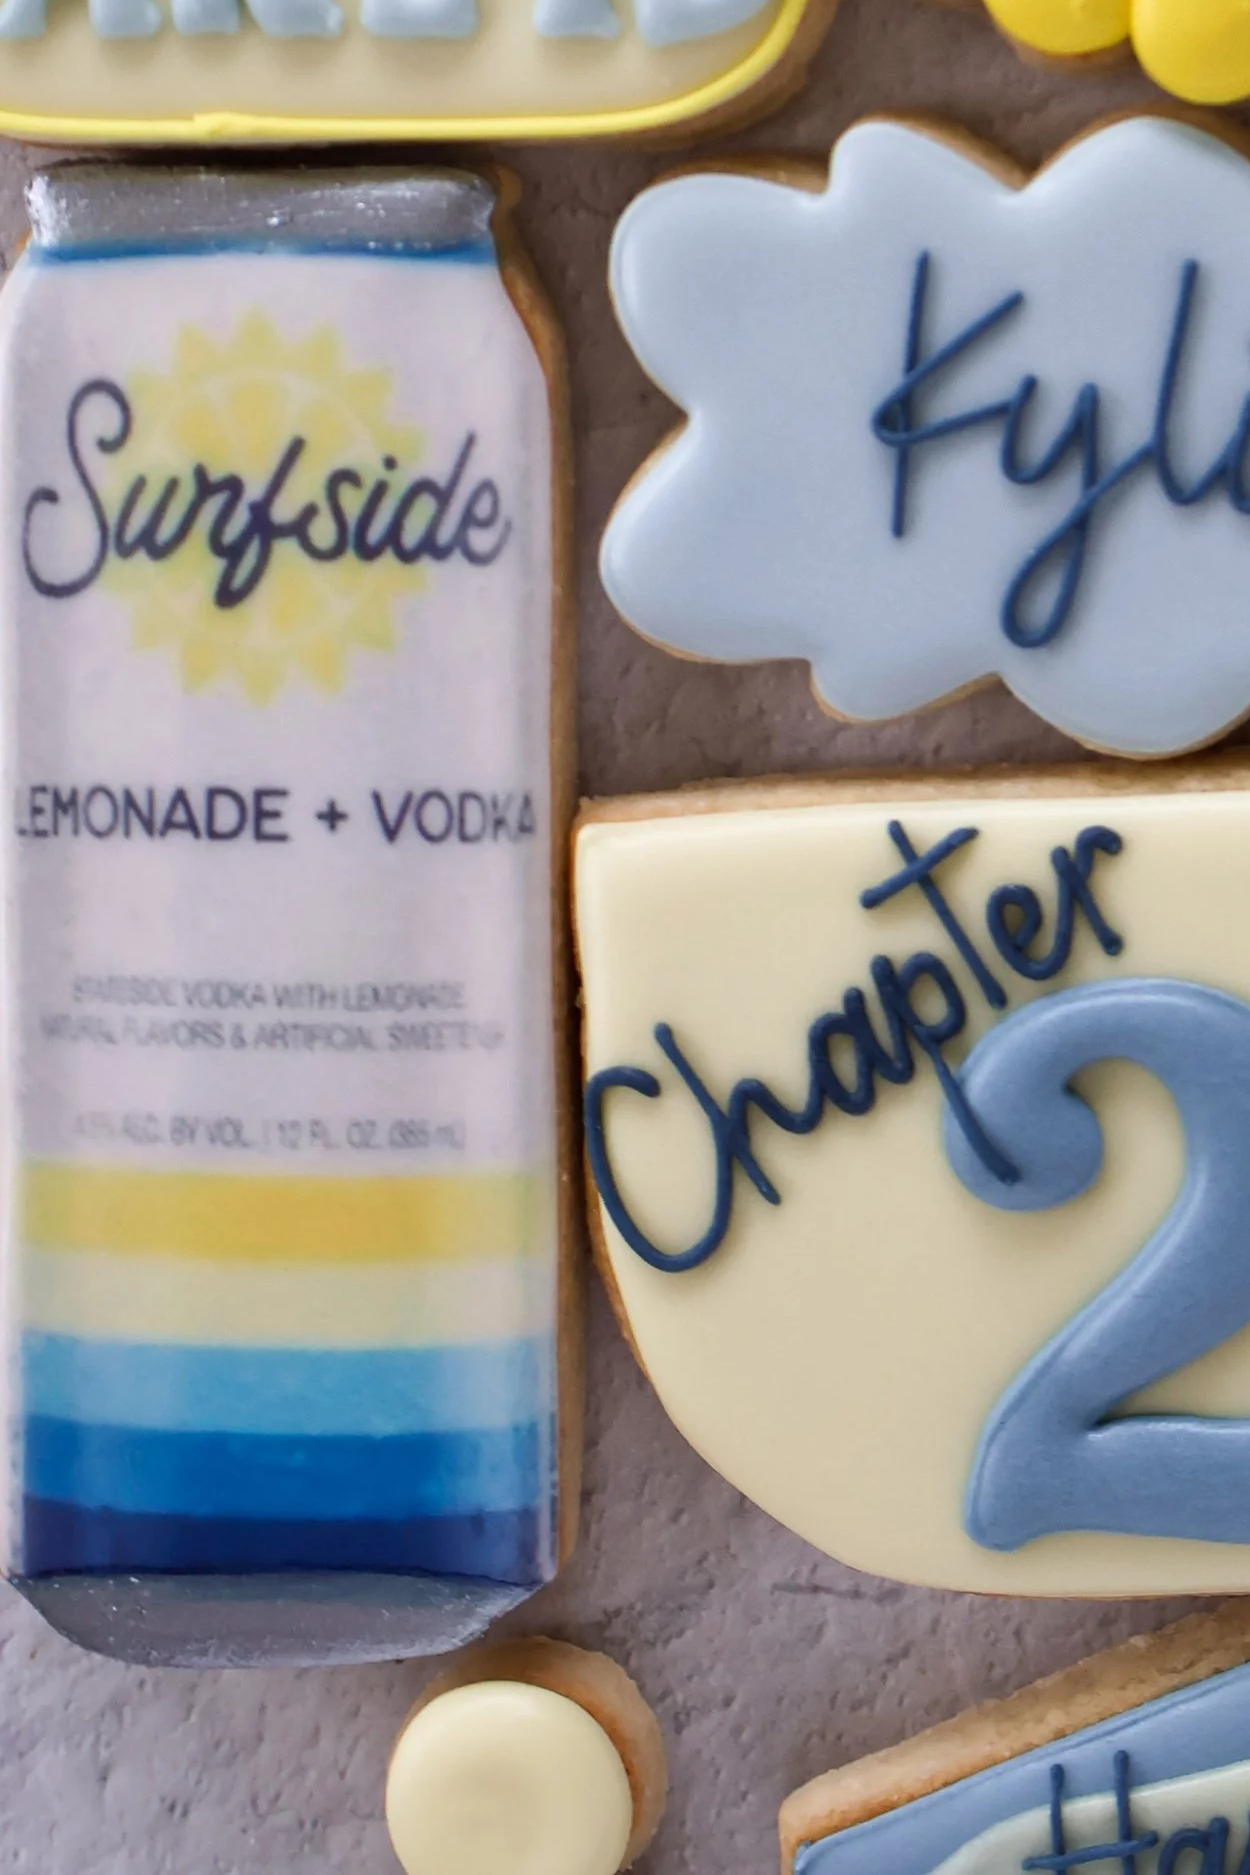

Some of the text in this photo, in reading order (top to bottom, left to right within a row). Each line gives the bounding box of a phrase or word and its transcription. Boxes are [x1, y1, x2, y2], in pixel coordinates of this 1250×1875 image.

[22, 378, 511, 609] Surfside
[371, 788, 537, 845] VODKA
[584, 819, 1125, 1273] Chapter
